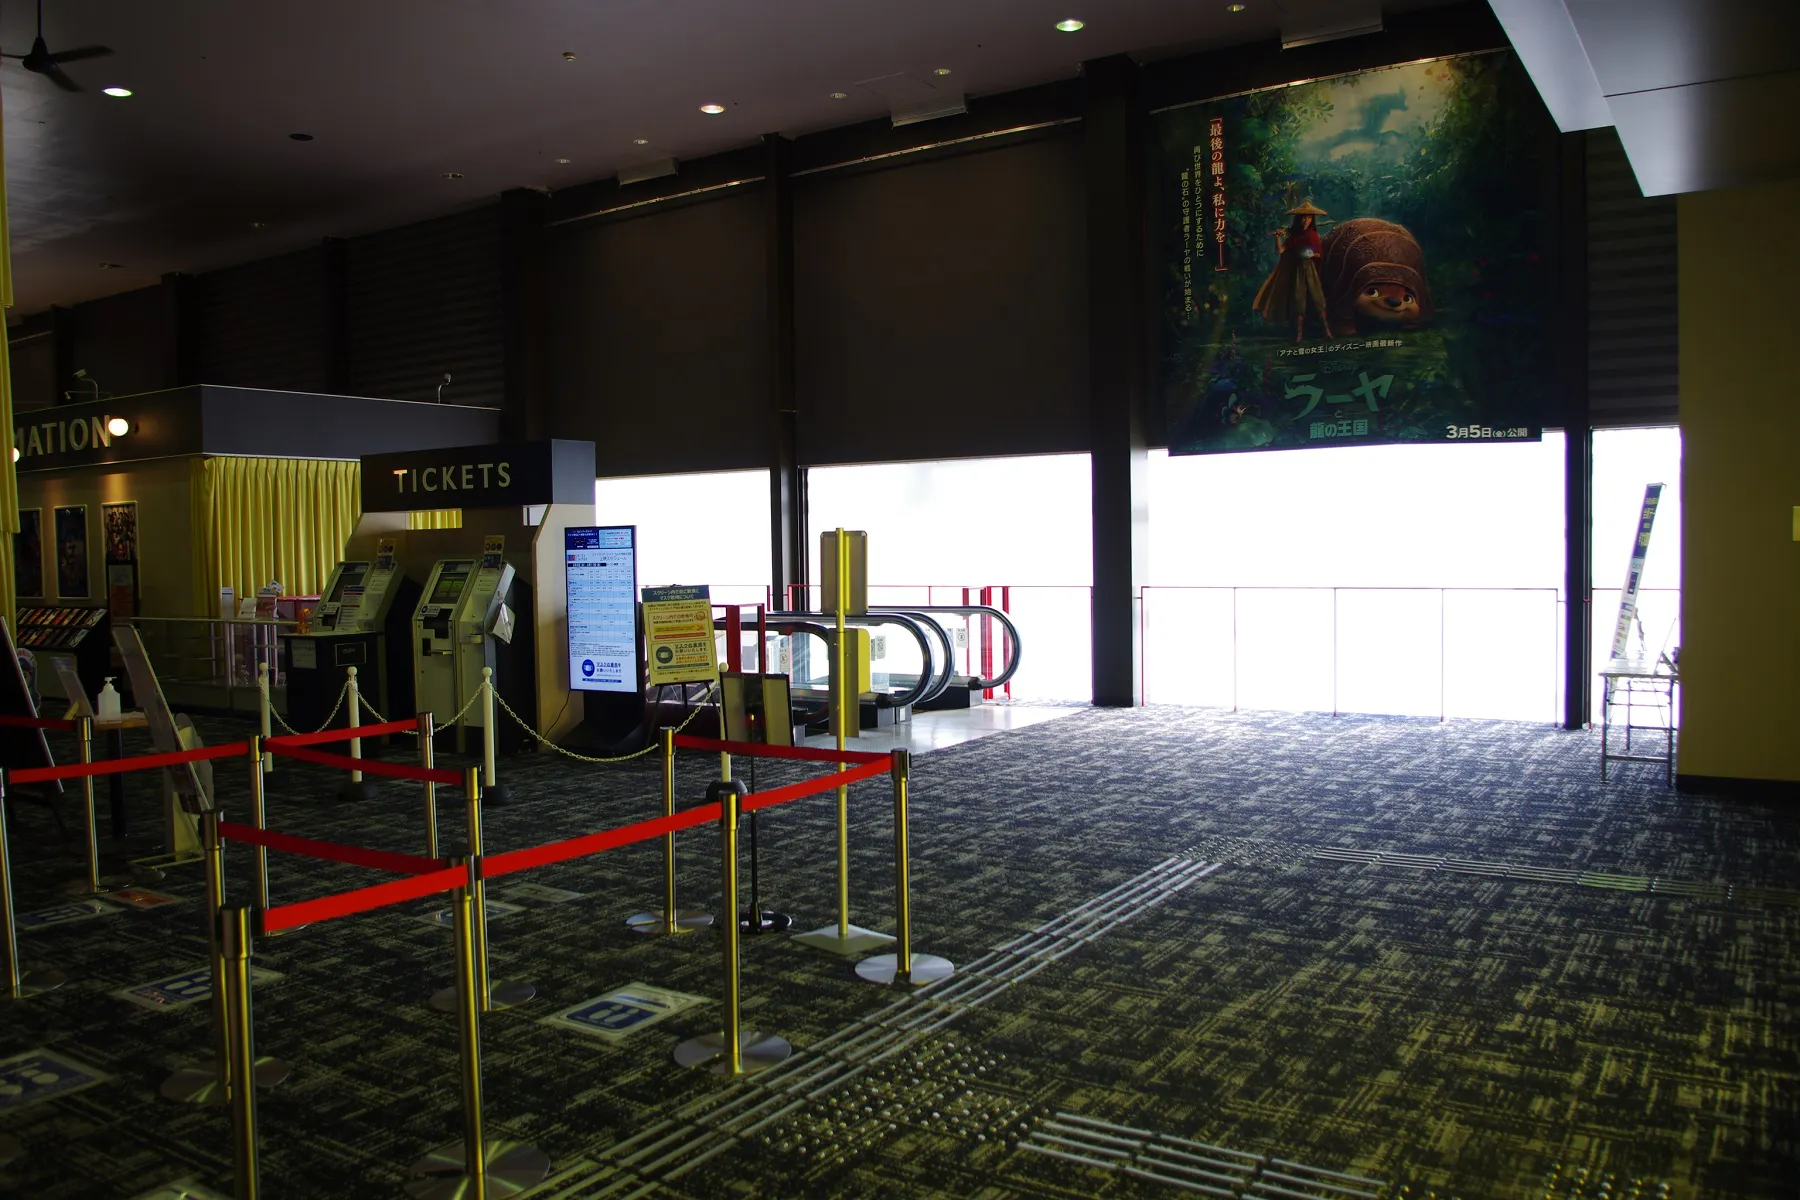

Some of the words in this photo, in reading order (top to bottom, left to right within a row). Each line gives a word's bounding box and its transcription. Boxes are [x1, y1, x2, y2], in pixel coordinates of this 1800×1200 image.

[1193, 145, 1205, 257] 再び世界をひとつにするために
[1283, 371, 1395, 421] ラーヤ
[1309, 418, 1369, 440] 龍の王国
[1335, 409, 1344, 419] と
[392, 461, 512, 493] TICKETS
